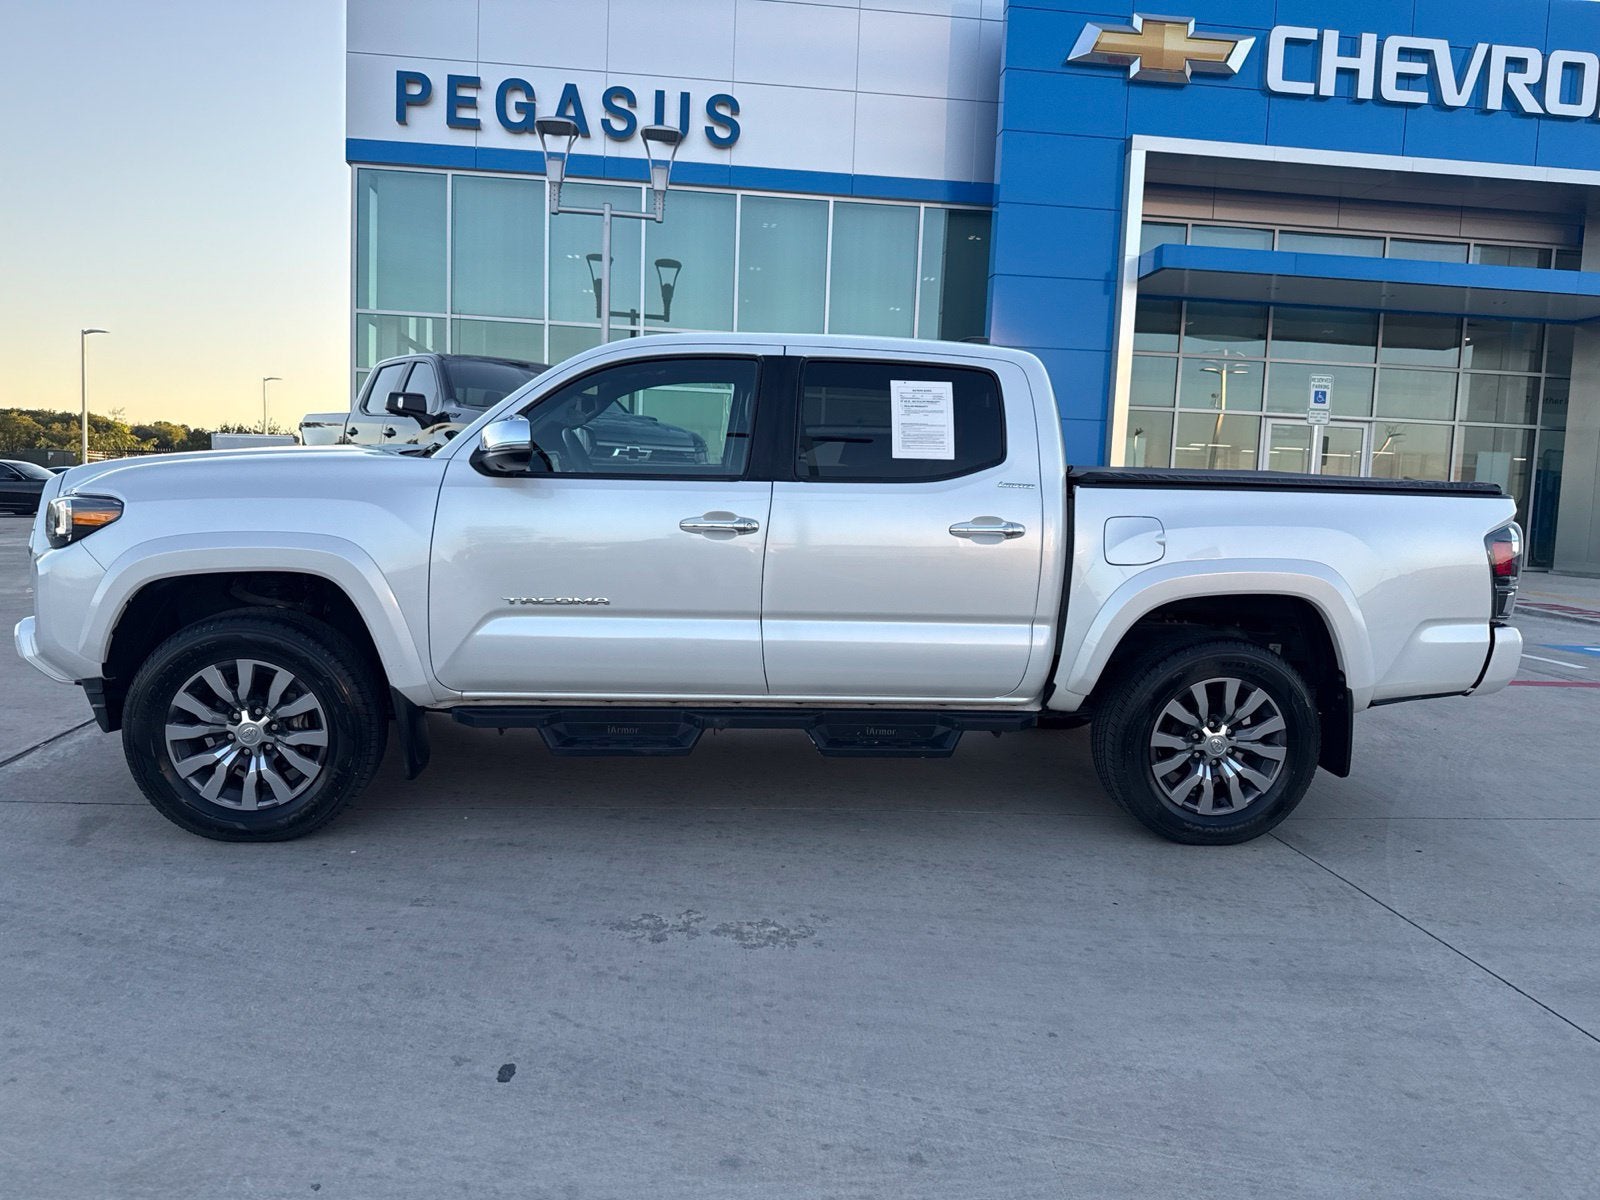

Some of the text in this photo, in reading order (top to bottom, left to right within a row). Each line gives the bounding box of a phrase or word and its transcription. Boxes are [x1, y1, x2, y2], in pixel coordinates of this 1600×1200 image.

[396, 70, 741, 148] PEGASUS
[1266, 25, 1600, 118] CHEVRO
[501, 597, 610, 605] TACOMA
